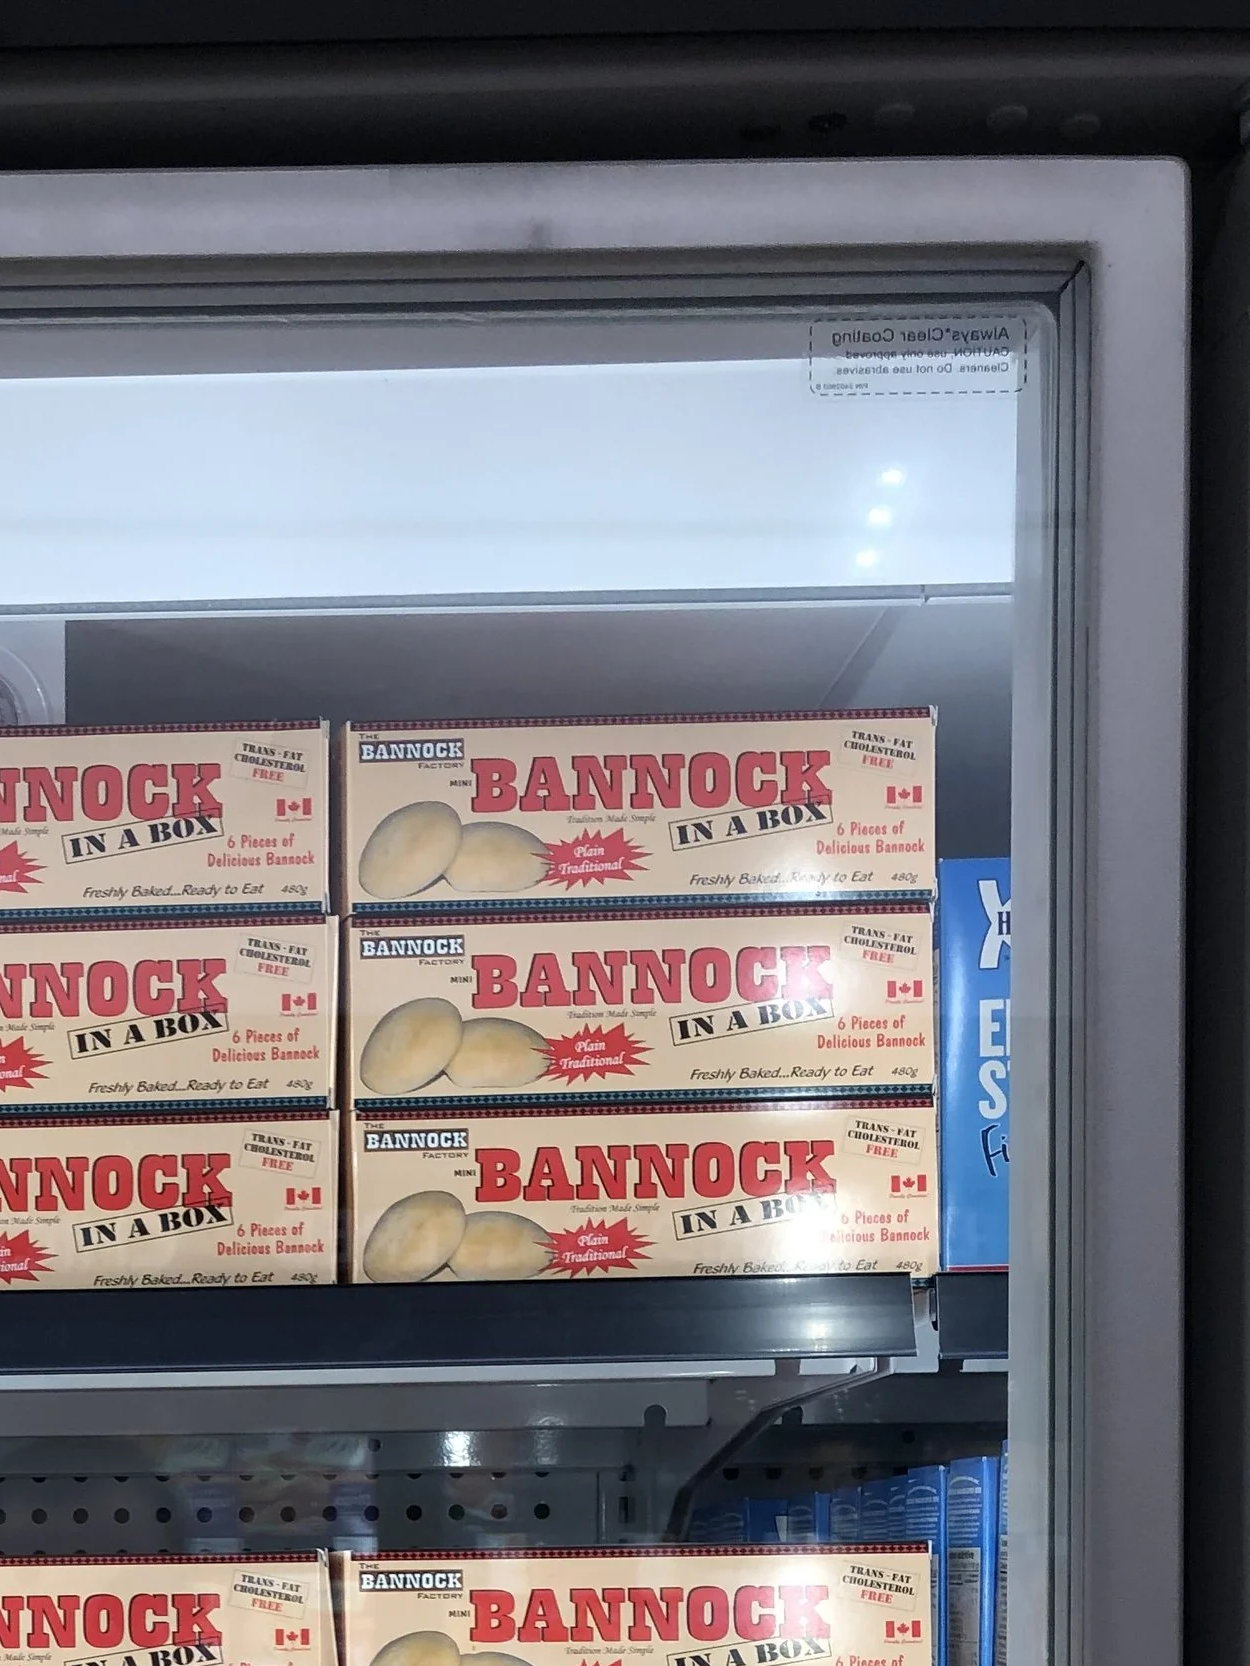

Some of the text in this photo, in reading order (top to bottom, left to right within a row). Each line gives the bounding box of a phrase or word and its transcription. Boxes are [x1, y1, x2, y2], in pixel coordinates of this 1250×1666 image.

[242, 743, 304, 762] TRANS FAT
[233, 753, 306, 774] CHOLESTEROL
[251, 767, 285, 781] FREE
[470, 750, 833, 813] BANNOCK
[471, 945, 833, 1009] BANNOCK
[474, 1140, 837, 1202] BANNOCK
[576, 1233, 609, 1247] Plain
[563, 1247, 628, 1263] Traditional
[359, 1573, 463, 1590] BANNOCK
[469, 1585, 832, 1643] BANNOCK
